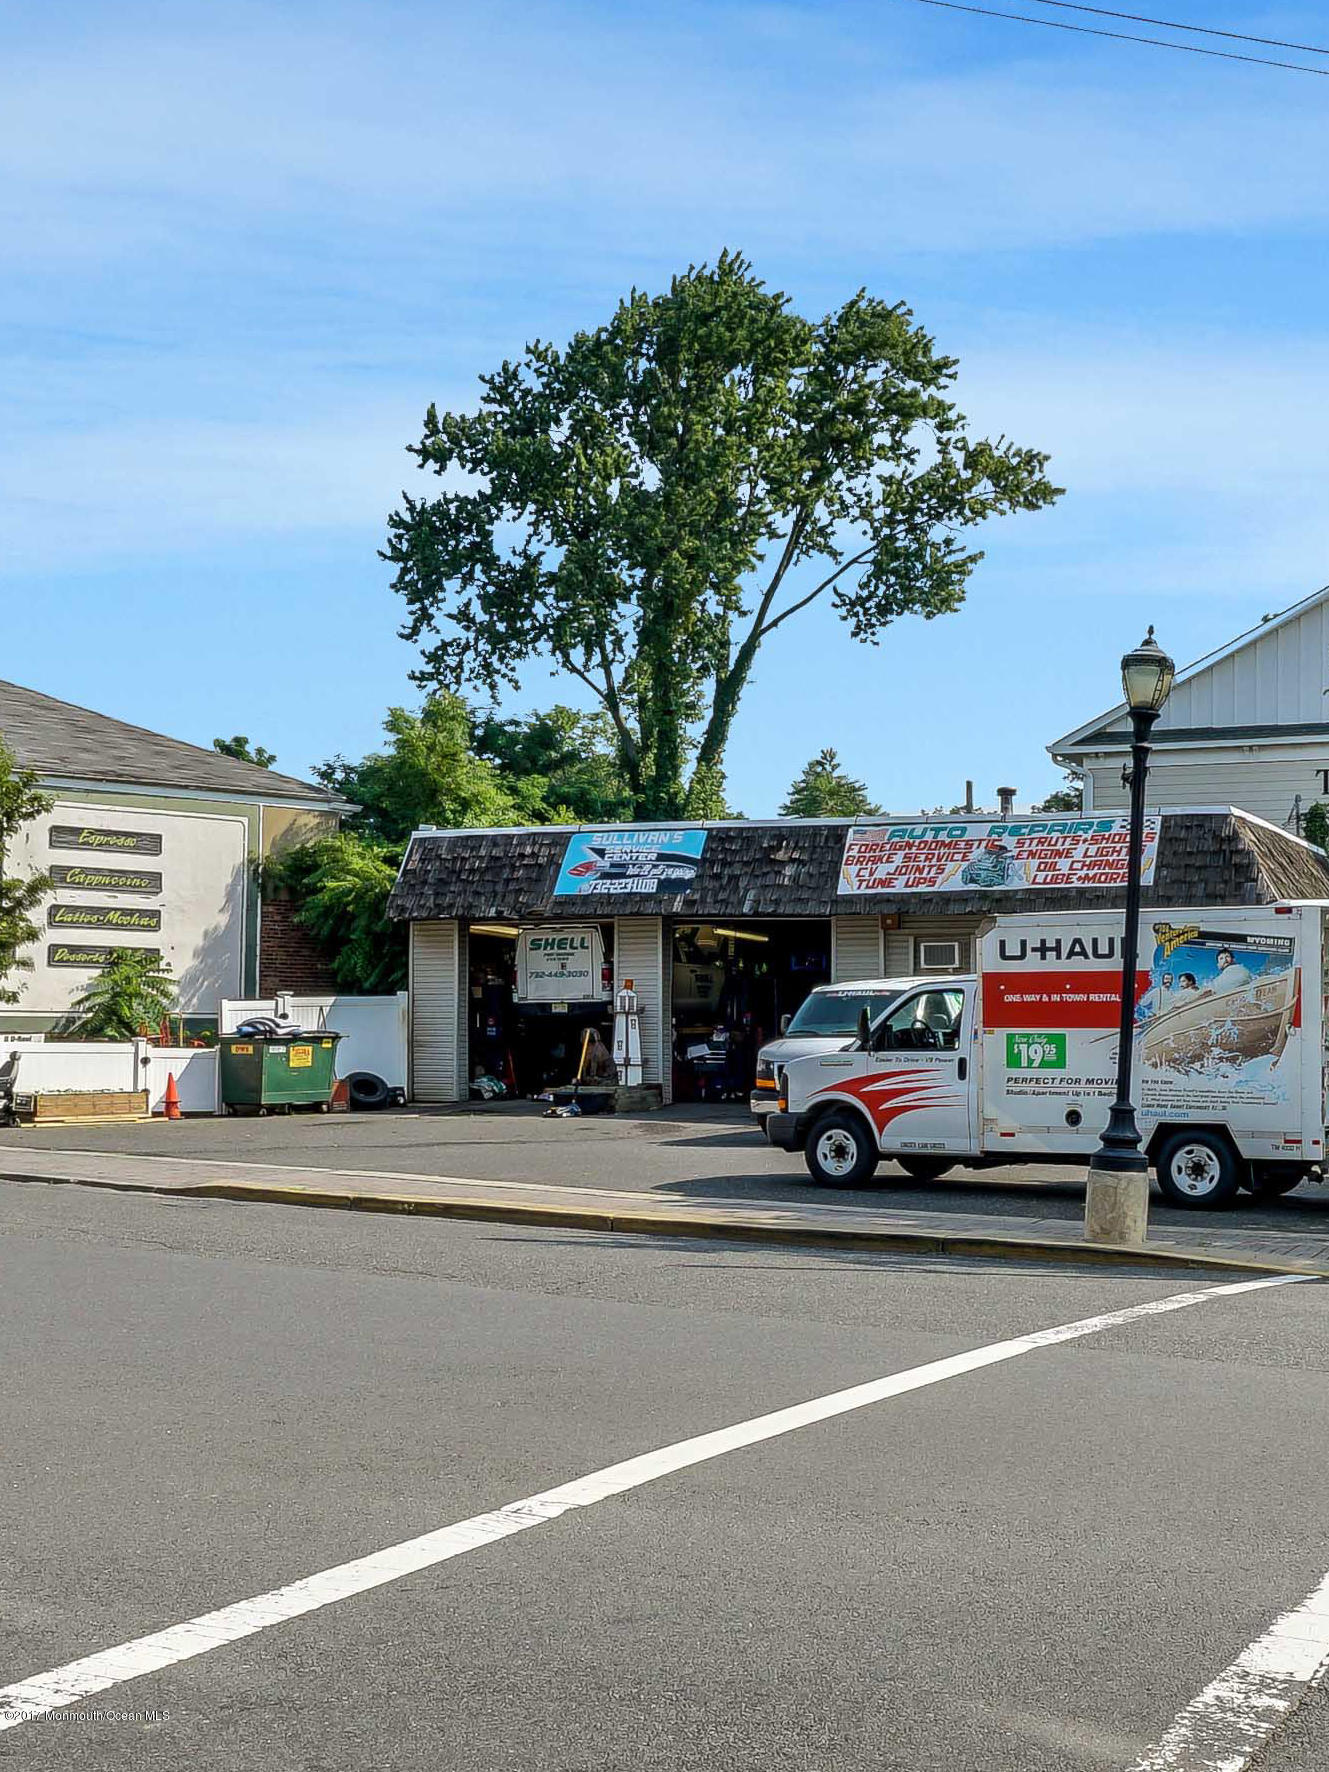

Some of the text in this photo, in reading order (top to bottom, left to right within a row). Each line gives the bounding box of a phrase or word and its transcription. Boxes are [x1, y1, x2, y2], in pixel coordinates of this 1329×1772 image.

[887, 819, 1116, 841] AUTO REPAIRS
[78, 829, 137, 847] Espresso
[592, 831, 685, 844] SULLIVAN'S
[1014, 835, 1082, 849] STRUTS
[1088, 831, 1157, 845] SHOCS
[604, 845, 660, 853] SERVICE
[846, 838, 1003, 854] FOREIGN-DOMESTIC
[1014, 845, 1147, 860] ENGINE LIGHT
[604, 853, 657, 861] CENTER
[843, 851, 974, 866] BRAKE SERVICE
[855, 864, 948, 878] CV JOINTS
[1035, 858, 1130, 872] OIL CHANG
[66, 868, 149, 887] Cappuccino
[856, 876, 939, 890] TUNE UPS
[1031, 873, 1075, 886] LUBE
[529, 937, 589, 951] SHELL
[1247, 936, 1290, 946] WYOMING
[1006, 1077, 1058, 1085] PERFECT
[1060, 1077, 1081, 1085] FOR
[1141, 1109, 1189, 1118] uhaul.com
